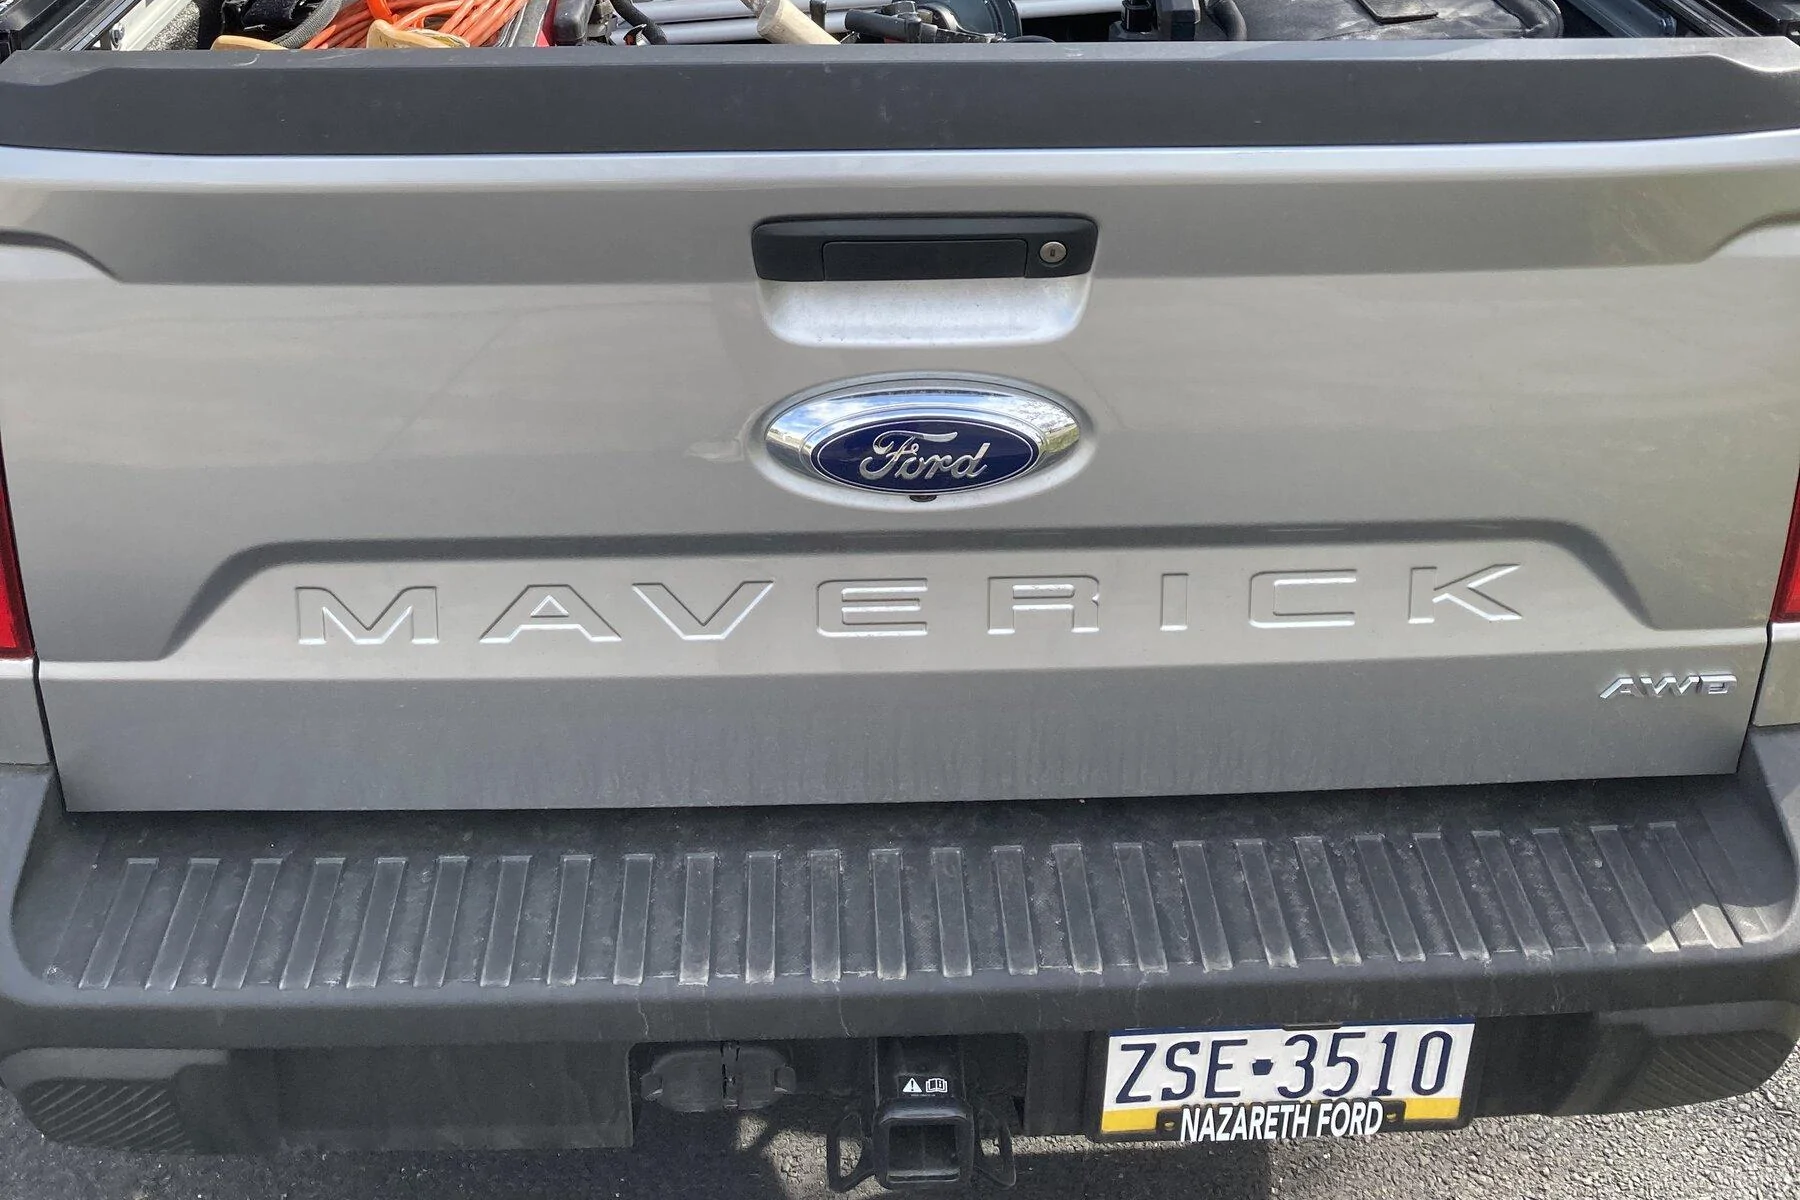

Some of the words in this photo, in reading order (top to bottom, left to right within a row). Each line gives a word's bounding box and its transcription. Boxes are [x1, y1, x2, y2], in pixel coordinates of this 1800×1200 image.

[859, 430, 990, 481] Ford
[295, 564, 1522, 645] MAVERICK
[1600, 675, 1737, 699] AWD
[1180, 1103, 1310, 1142] NAZARETH
[1317, 1101, 1383, 1138] FORD
